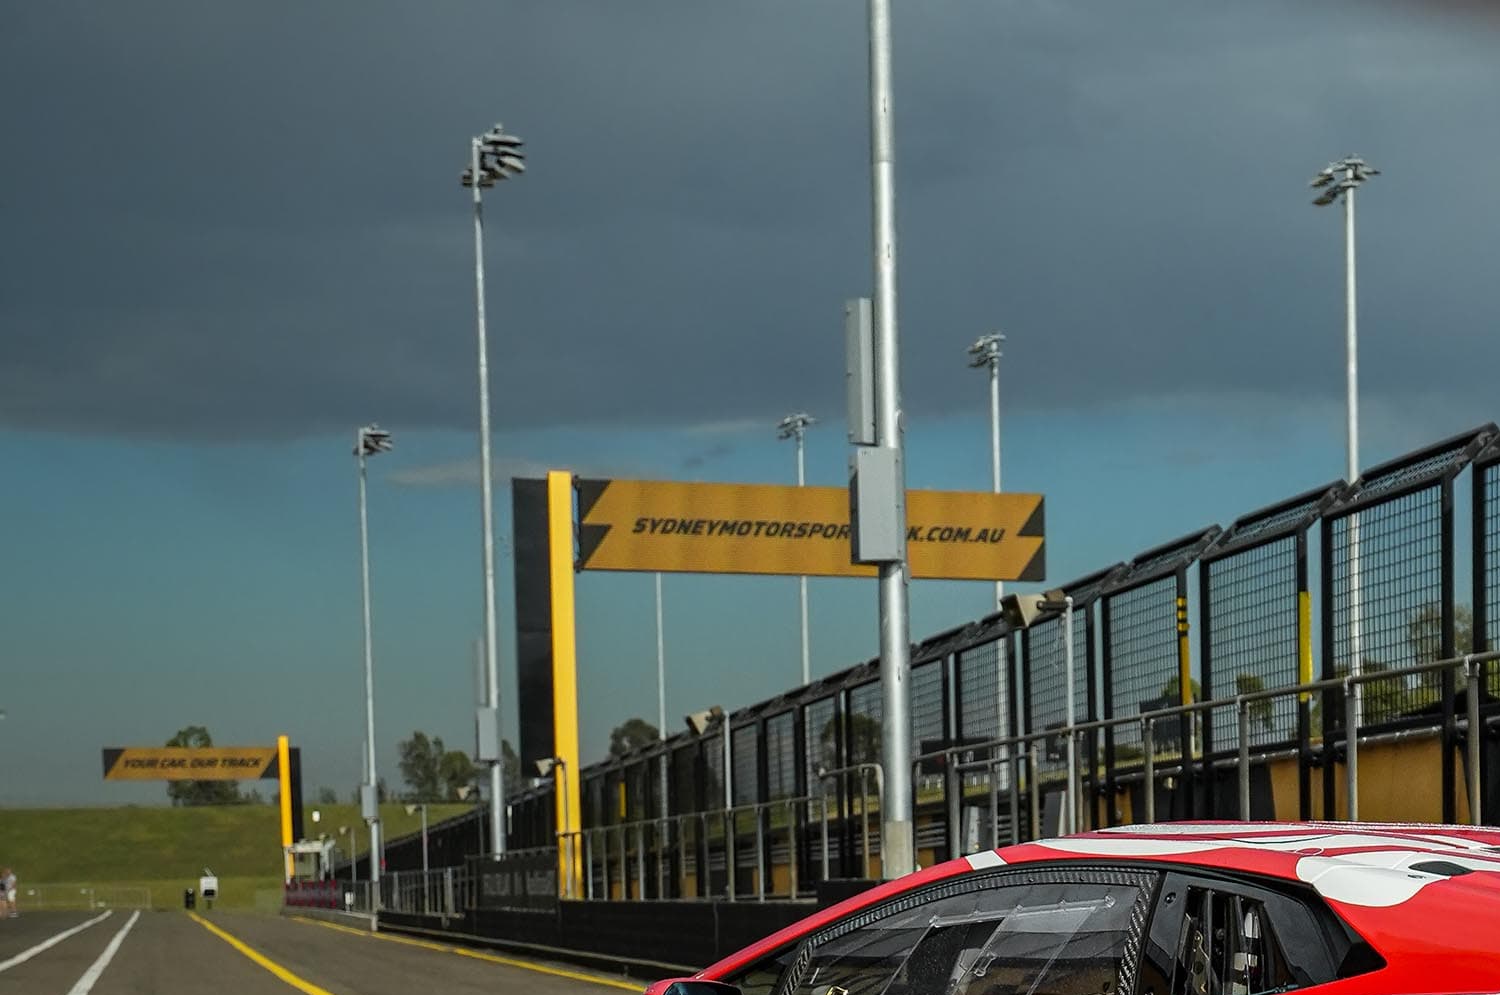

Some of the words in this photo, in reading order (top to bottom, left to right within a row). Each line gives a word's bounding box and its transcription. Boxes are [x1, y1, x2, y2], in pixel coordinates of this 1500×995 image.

[124, 757, 158, 769] YOUR
[190, 757, 219, 769] OUR
[220, 757, 262, 769] TRACK
